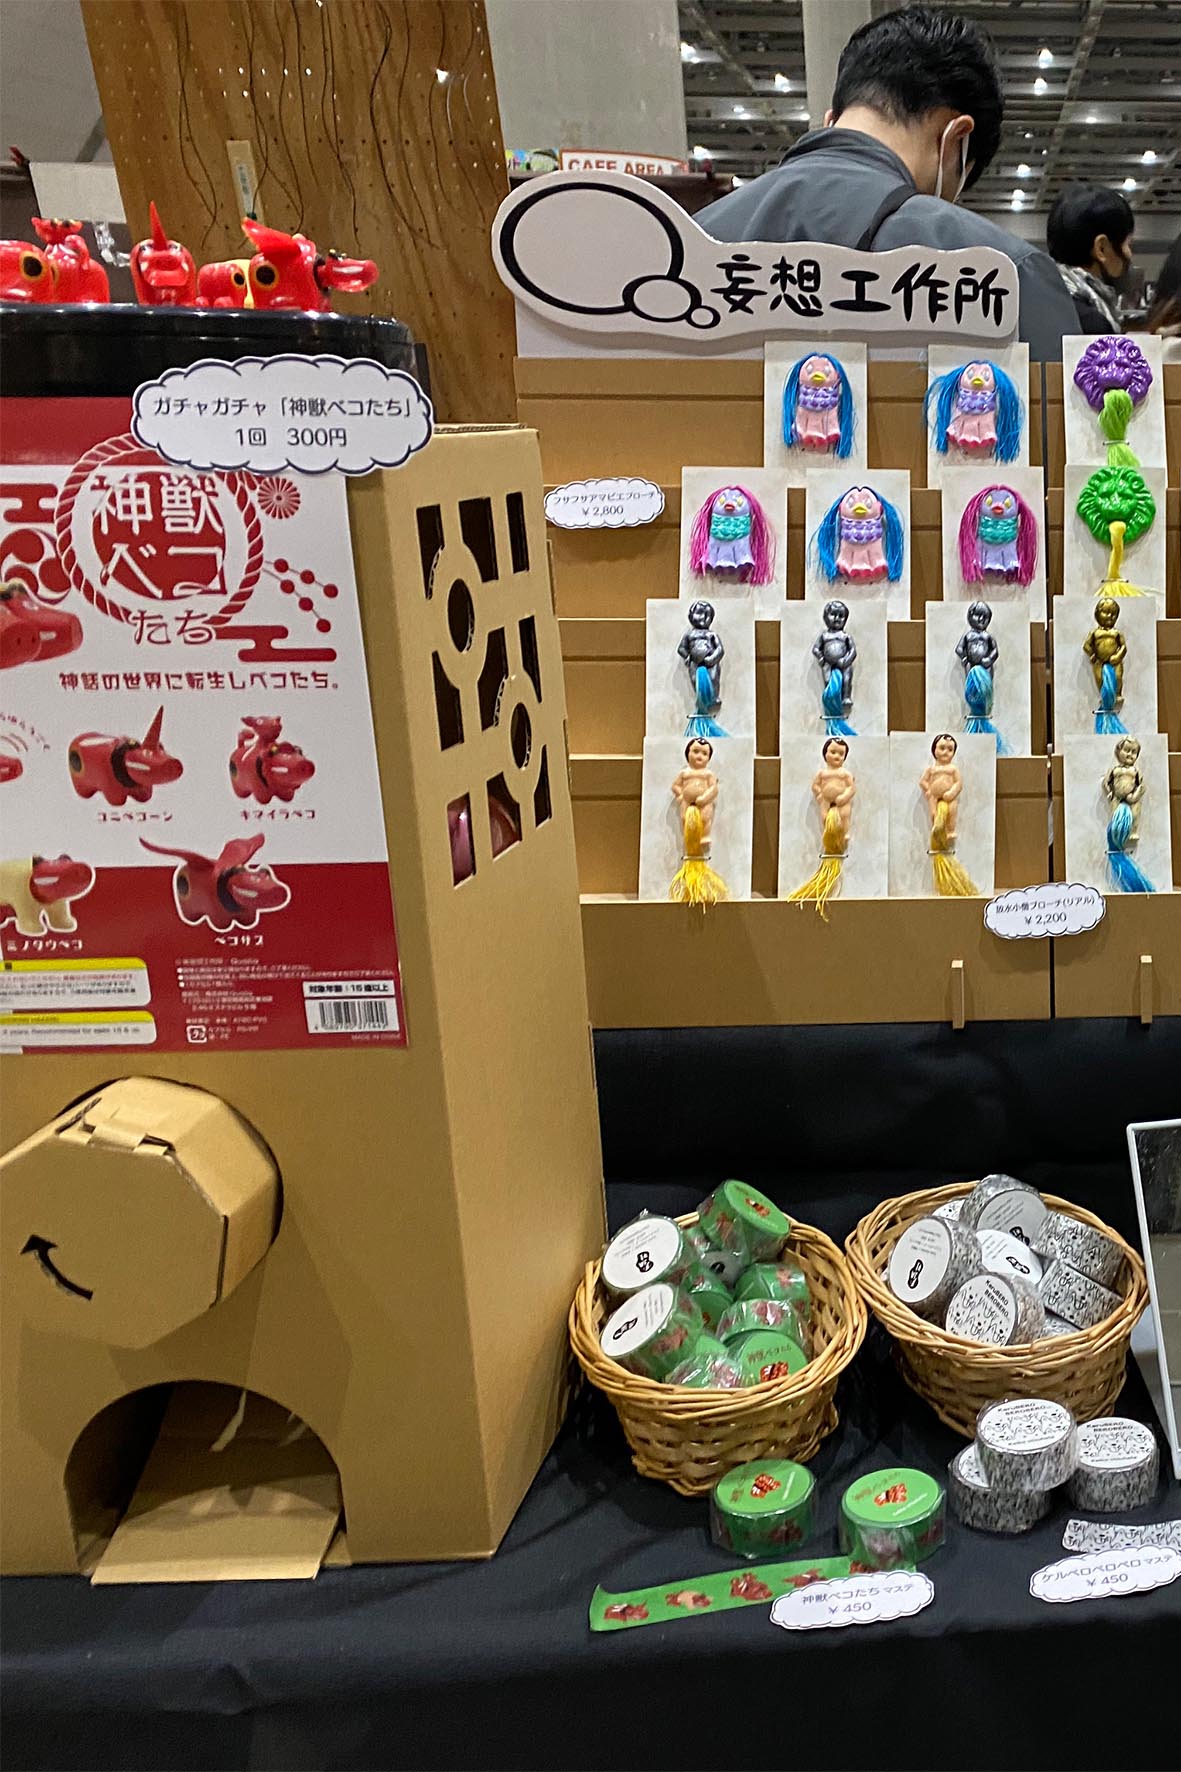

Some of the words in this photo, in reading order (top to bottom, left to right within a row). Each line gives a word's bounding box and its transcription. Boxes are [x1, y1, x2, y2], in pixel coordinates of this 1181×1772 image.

[711, 254, 1010, 327] 妄想工作所
[286, 427, 348, 448] 300円
[133, 609, 217, 645] たち
